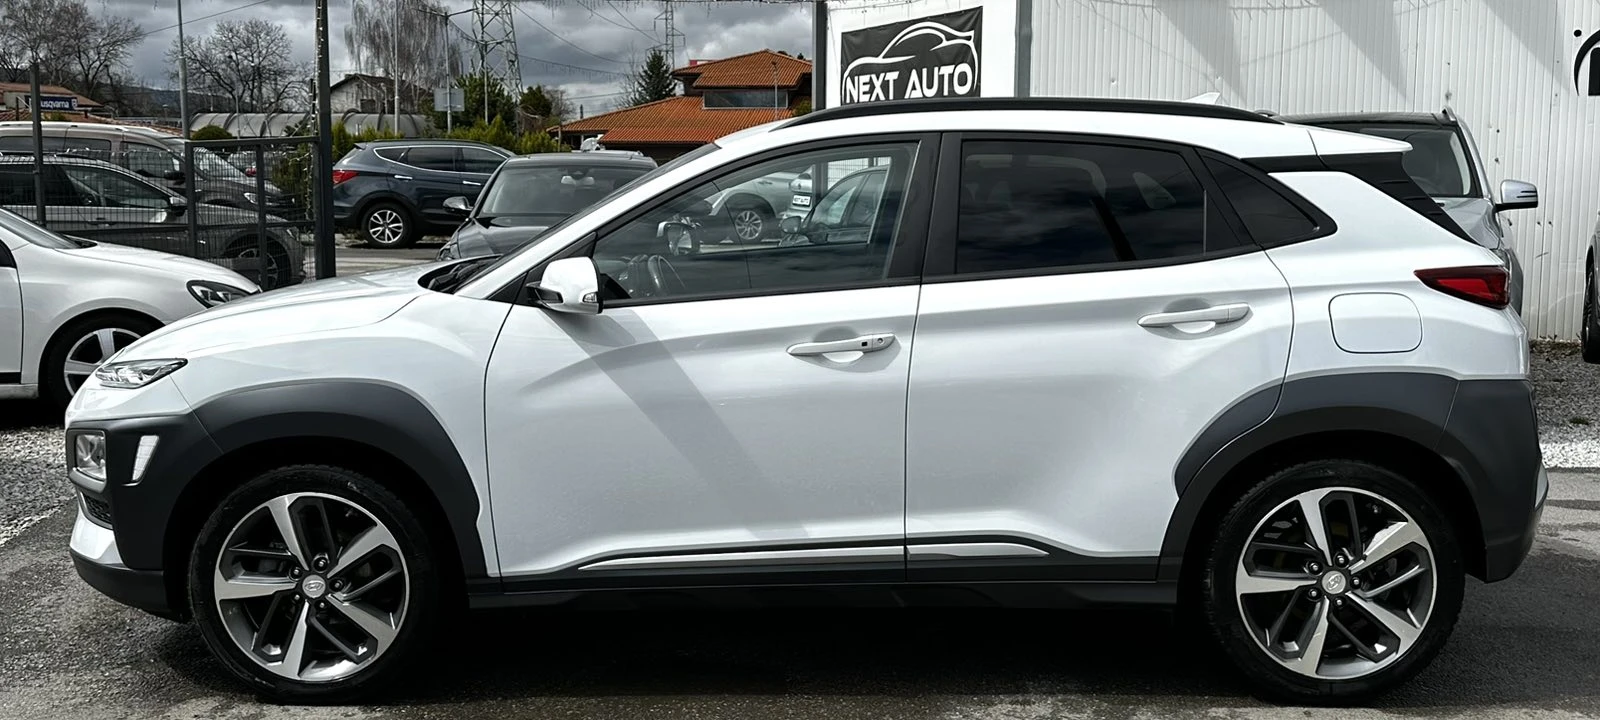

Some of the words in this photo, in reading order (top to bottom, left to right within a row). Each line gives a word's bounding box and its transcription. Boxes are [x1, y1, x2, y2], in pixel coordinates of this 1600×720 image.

[846, 71, 899, 103] NEXT
[904, 63, 973, 99] AUTO
[38, 99, 70, 109] usqvarna
